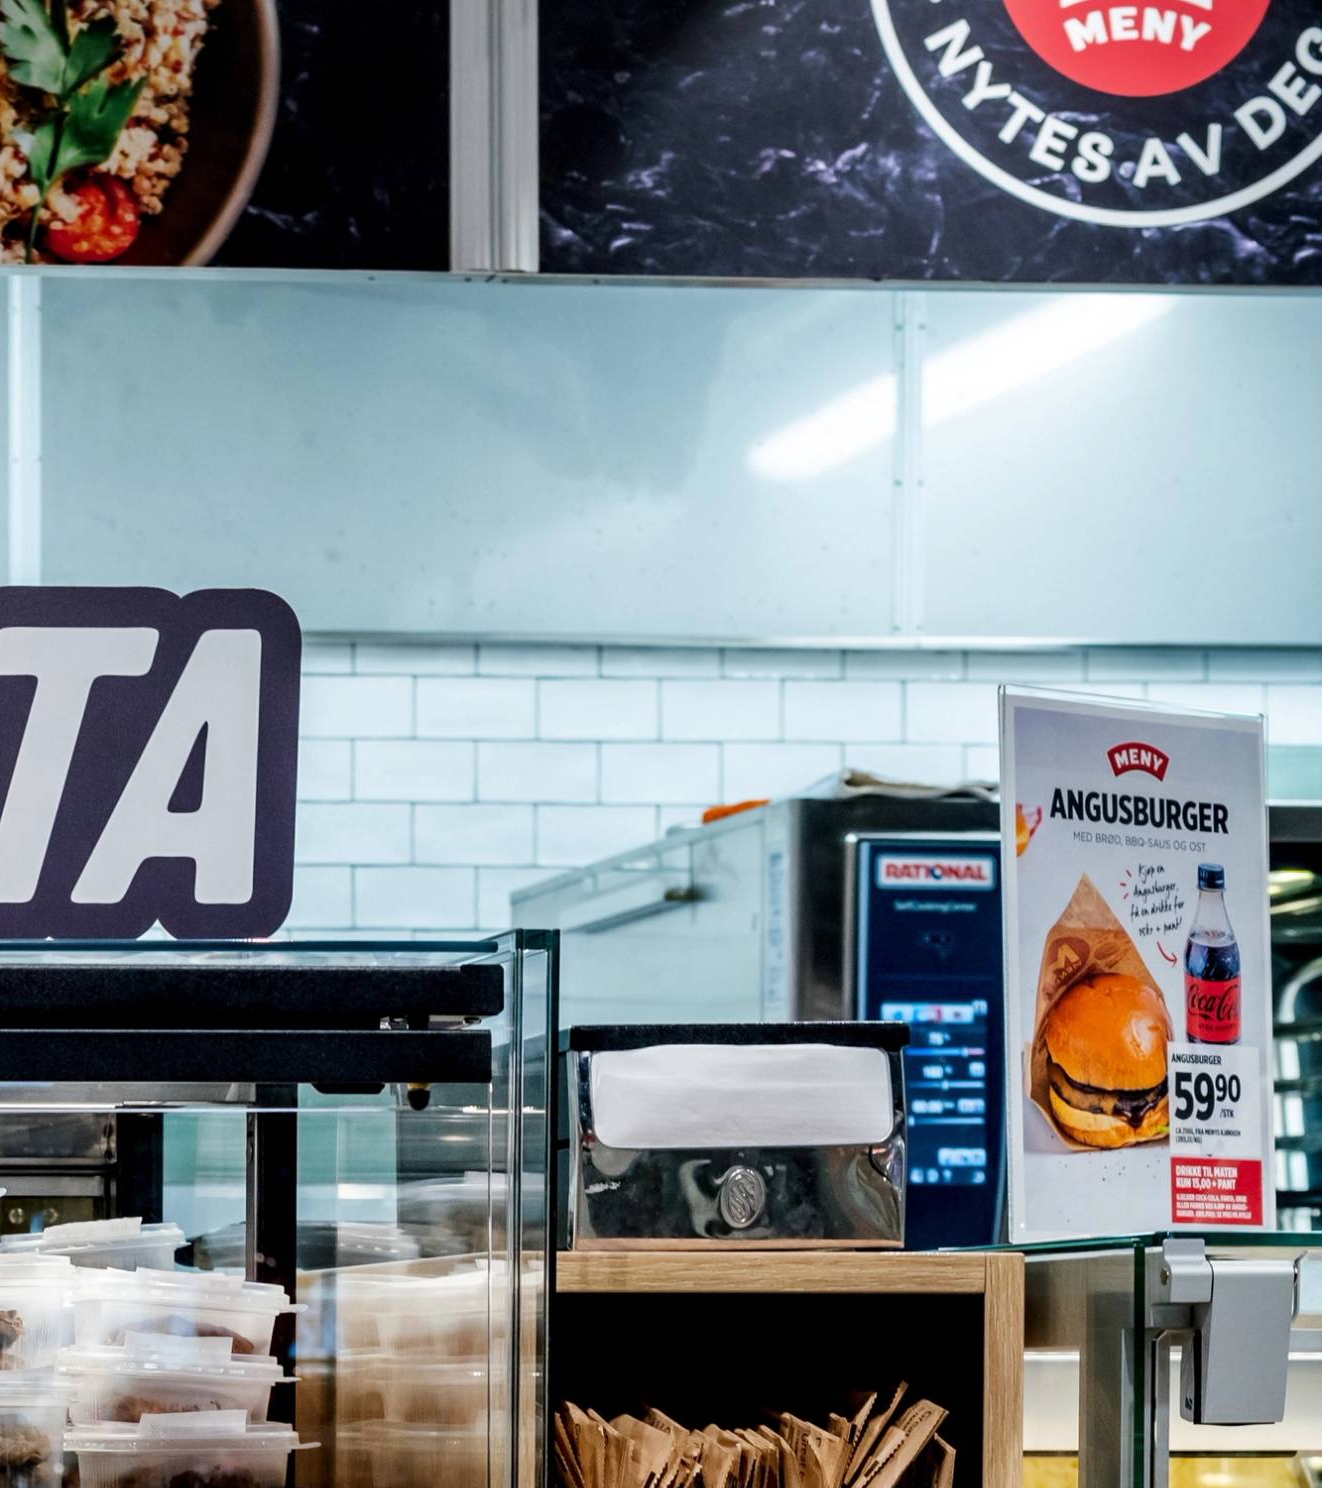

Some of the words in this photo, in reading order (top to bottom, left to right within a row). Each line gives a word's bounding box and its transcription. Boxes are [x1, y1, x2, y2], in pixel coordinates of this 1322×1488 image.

[1063, 7, 1212, 52] MENY
[924, 18, 1114, 183] NYTES
[1133, 123, 1222, 188] AV
[1114, 748, 1163, 771] MENY
[1050, 787, 1229, 834] ANGUSBURGER
[1073, 832, 1093, 842] MED
[1125, 837, 1171, 849] BBQ-SAUS
[1174, 841, 1186, 851] OG
[1190, 842, 1206, 852] OST
[885, 862, 986, 881] RATIONAL
[1171, 1054, 1222, 1065] ANGUSBURGER
[1214, 1166, 1238, 1178] MATEN
